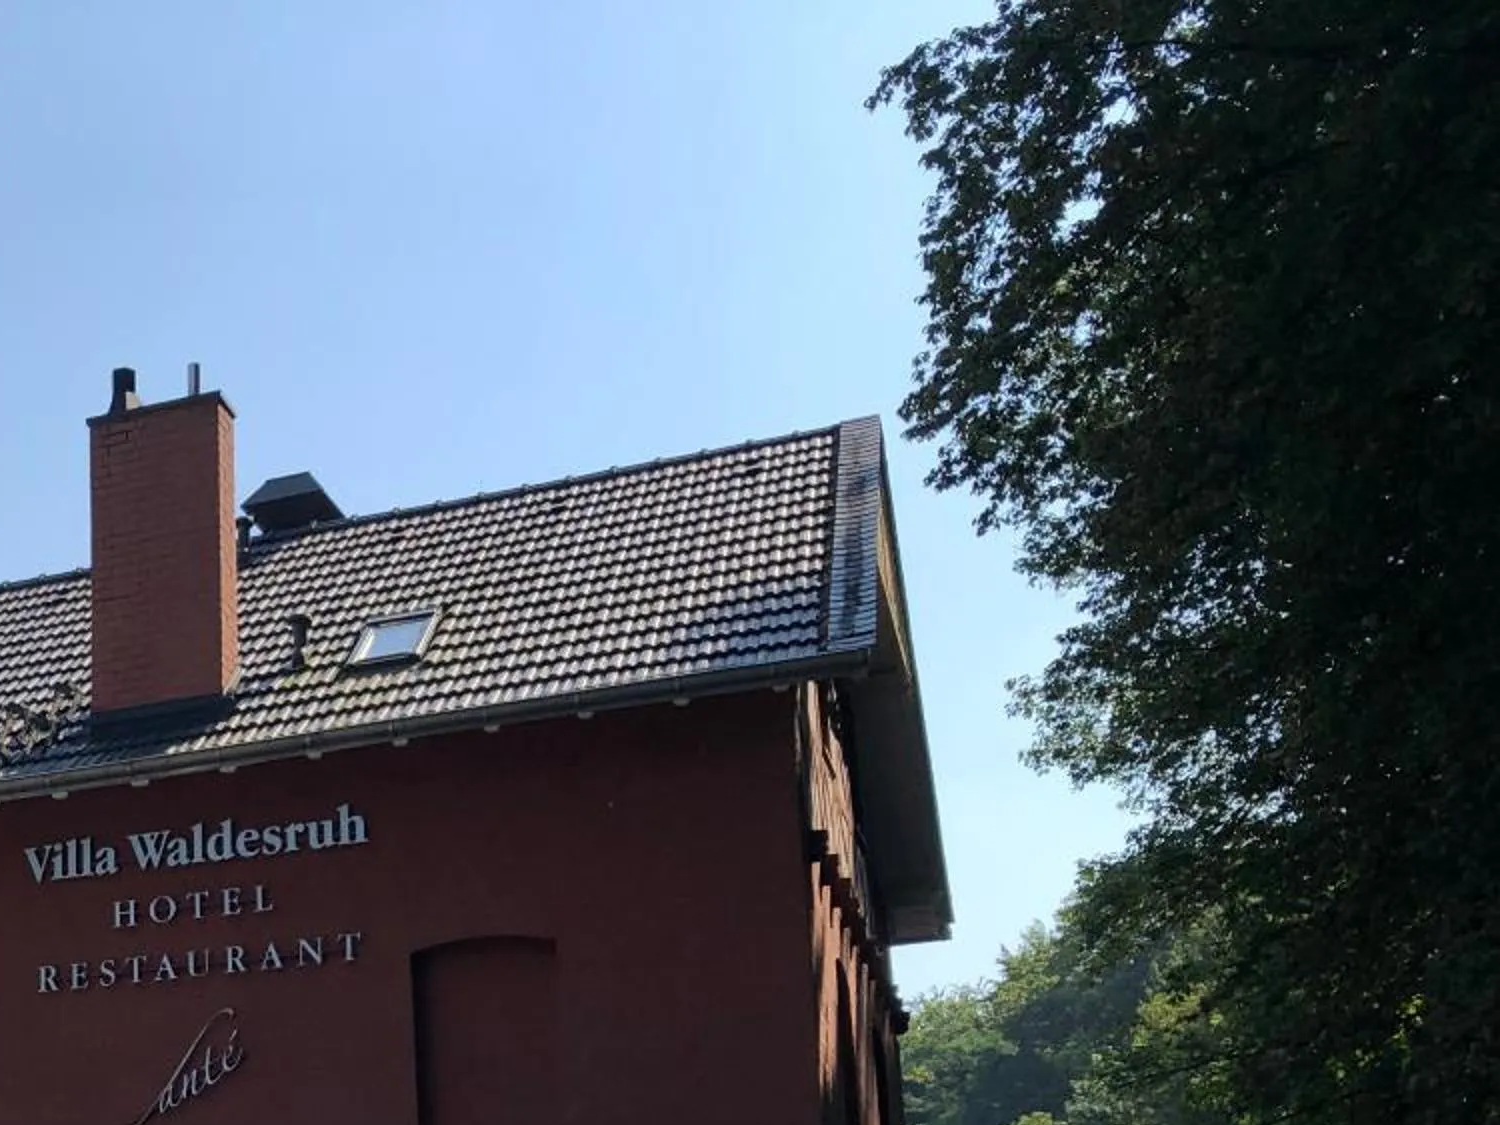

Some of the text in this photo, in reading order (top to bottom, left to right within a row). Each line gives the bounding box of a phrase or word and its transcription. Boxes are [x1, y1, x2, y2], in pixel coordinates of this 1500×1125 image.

[24, 803, 369, 885] Villa Waldesruh
[113, 885, 274, 928] HOTEL
[37, 932, 361, 993] RESTAURANT
